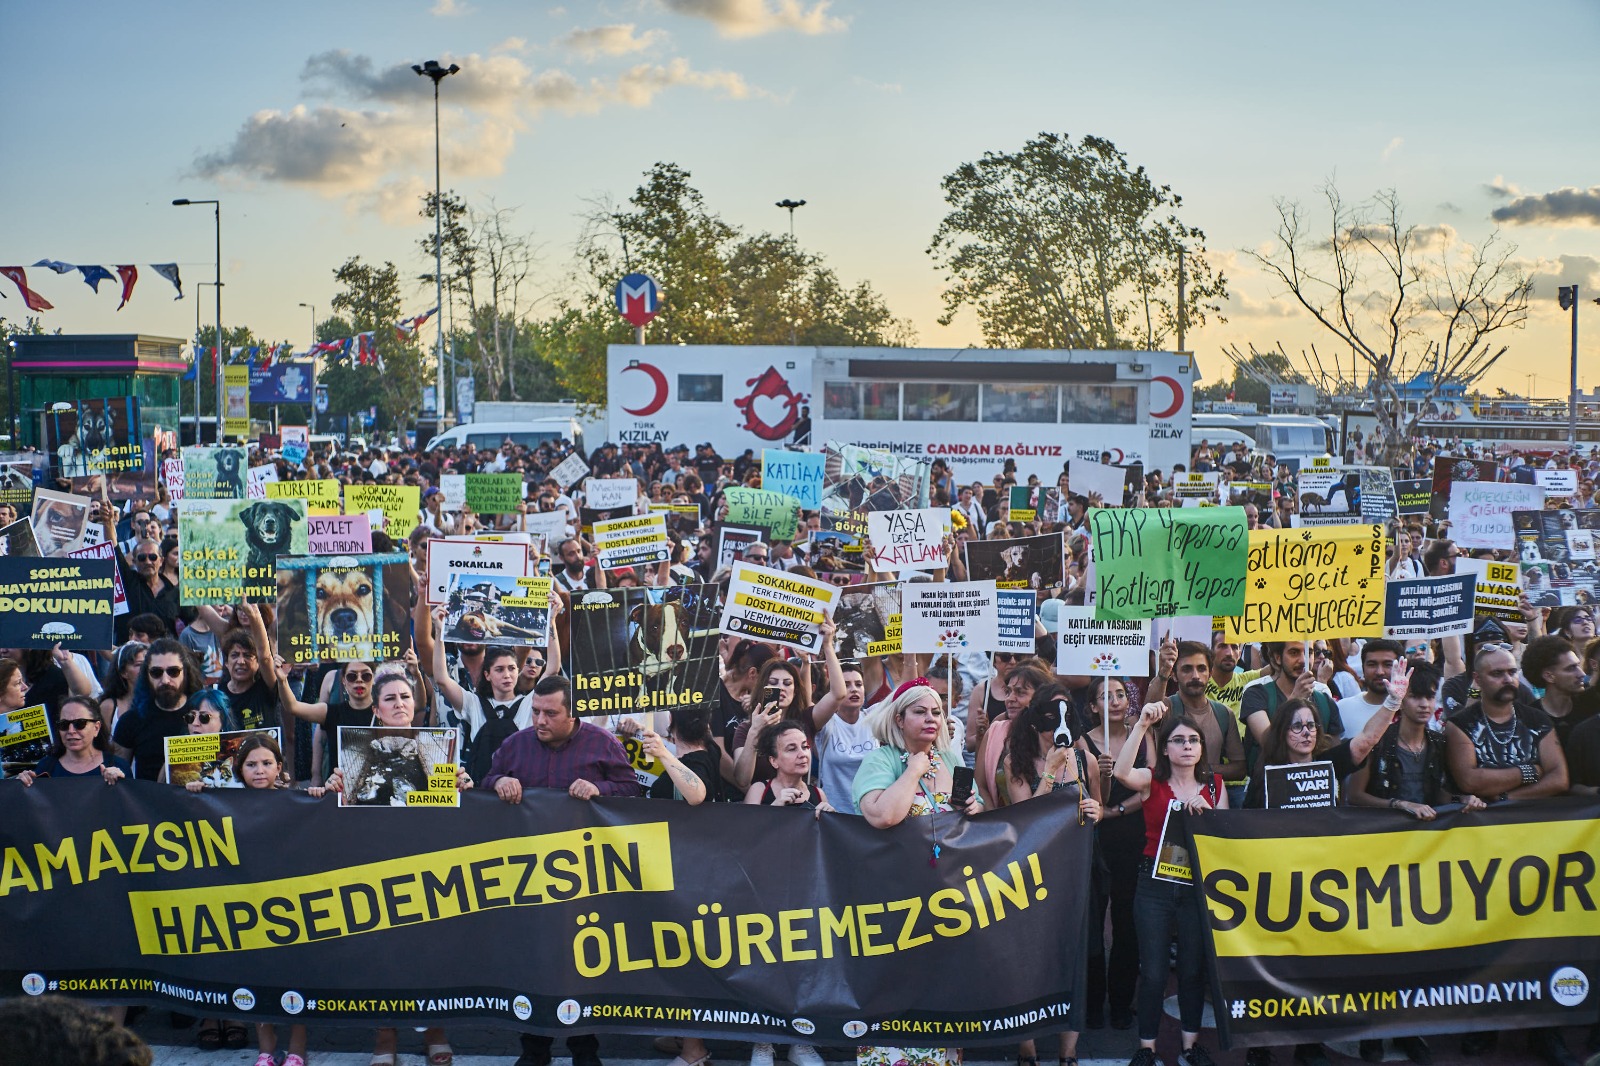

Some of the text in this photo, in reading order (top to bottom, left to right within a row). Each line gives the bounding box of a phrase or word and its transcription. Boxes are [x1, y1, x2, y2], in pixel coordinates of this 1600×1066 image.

[619, 430, 669, 442] KIZILAY
[1149, 429, 1183, 439] IZILAY
[104, 444, 141, 456] senin
[926, 442, 1063, 456] CANDAN BAĞLIYIZ
[87, 458, 142, 471] komşun
[951, 455, 995, 464] bağışçımız
[185, 480, 233, 490] köpekleri,
[362, 486, 397, 497] SORUN
[185, 488, 234, 500] komşumuz
[352, 494, 404, 504] HAYVANLARIN
[730, 491, 784, 507] ŞEYTAN
[780, 484, 818, 506] VAR!
[1464, 490, 1531, 503] KÖPEKLERİN
[742, 507, 773, 520] BİLE
[833, 508, 850, 518] siz
[308, 520, 353, 536] DEVLET
[607, 518, 652, 532] SOKAKLARI
[884, 511, 926, 533] YASA
[86, 528, 99, 537] NE
[606, 527, 655, 540] TERK ETMİYORUZ
[891, 531, 925, 544] DEĞİL
[1093, 508, 1244, 562] AKP Yaparsa
[83, 537, 97, 546] NE
[605, 535, 658, 549] DOSTLARIMIZI
[182, 546, 239, 561] sokak
[607, 544, 658, 558] VERMİYORUZ!
[873, 542, 943, 567] KATLİAM
[448, 559, 504, 570] SOKAKLAR
[30, 566, 81, 580] SOKAK
[183, 564, 277, 582] köpekleri,
[1491, 566, 1514, 581] BİZ
[0, 578, 114, 595] HAYVANLARINA
[517, 579, 549, 587] Kısırlaştır
[757, 574, 815, 597] SOKAKLARI
[1100, 561, 1247, 610] Katliam Yapar
[1283, 564, 1350, 601] geçit
[1400, 582, 1463, 596] KATLİAM YASASINA
[751, 585, 815, 609] TERK ETMİYORUZ
[921, 590, 981, 600] İNSAN İÇİN TEHDİT SOKAK
[1488, 584, 1522, 597] YASA
[0, 597, 112, 615] DOKUNMA
[502, 598, 549, 608] Yerinde Yaşat
[910, 601, 942, 609] HAYVANLARI
[943, 600, 956, 609] DEĞİL
[957, 600, 972, 608] ERKEK
[973, 598, 990, 609] ŞİDDETİ
[1398, 594, 1463, 609] KARŞI MÜCADELEYE,
[745, 596, 815, 623] DOSTLARIMIZI
[929, 609, 942, 618] FAİLİ
[943, 610, 965, 618] KORUYAN
[966, 609, 981, 617] ERKEK
[1229, 594, 1382, 636] VERMEYECEĞİZ
[1401, 606, 1459, 619] EYLEME, SOKAĞA!
[744, 609, 809, 632] VERMİYORUZ!
[938, 619, 966, 627] DEVLETTİR!
[1068, 618, 1143, 631] KATLİAM YASASINA
[742, 624, 799, 640] #YASAYIGERİÇEK
[1396, 626, 1426, 635] EZİLENLERİN
[1427, 624, 1450, 634] SOSYALİST
[290, 631, 400, 646] siz hiç barınak
[1063, 632, 1146, 648] GEÇİT VERMEYECEĞİZ!
[294, 645, 400, 663] gördünüz mü?
[869, 642, 903, 655] BARINA
[576, 672, 643, 692] hayatı
[576, 688, 704, 712] senin elinde
[8, 708, 43, 722] Kısırlaştır
[24, 717, 45, 728] Aşılat
[0, 727, 48, 745] Yerinde Yaşat
[168, 735, 220, 746] TOPLAYAMAZSIN
[169, 744, 220, 755] HAPSEDEMEZSİN
[169, 753, 216, 764] ÖLDÜREMEZSİN
[434, 766, 454, 774] ALIN
[1286, 769, 1330, 781] KATLİAM
[430, 777, 454, 788] SİZE
[1296, 779, 1330, 793] VAR!
[408, 794, 454, 804] BARINAK
[1290, 793, 1331, 803] HAYVANLARI
[0, 816, 241, 897] AMAZSIN
[1160, 864, 1188, 876] Yasakla
[152, 832, 643, 954] HAPSEDEMEZSİN
[1203, 850, 1597, 933] SUSMUYOR
[573, 852, 1050, 978] ÖLDÜREMEZSİN!
[48, 978, 227, 1005] #SOKAKTAYIMYANINDAYIM
[1231, 980, 1542, 1019] #SOKAKTAYIMYANINDAYIM
[306, 996, 509, 1020] #SOKAKTAYIMYANINDAYIM
[582, 1004, 787, 1028] #SOKAKTAYIMYANINDAYIM
[870, 1002, 1072, 1032] #SOKAKTAYIMYANINDAYIM
